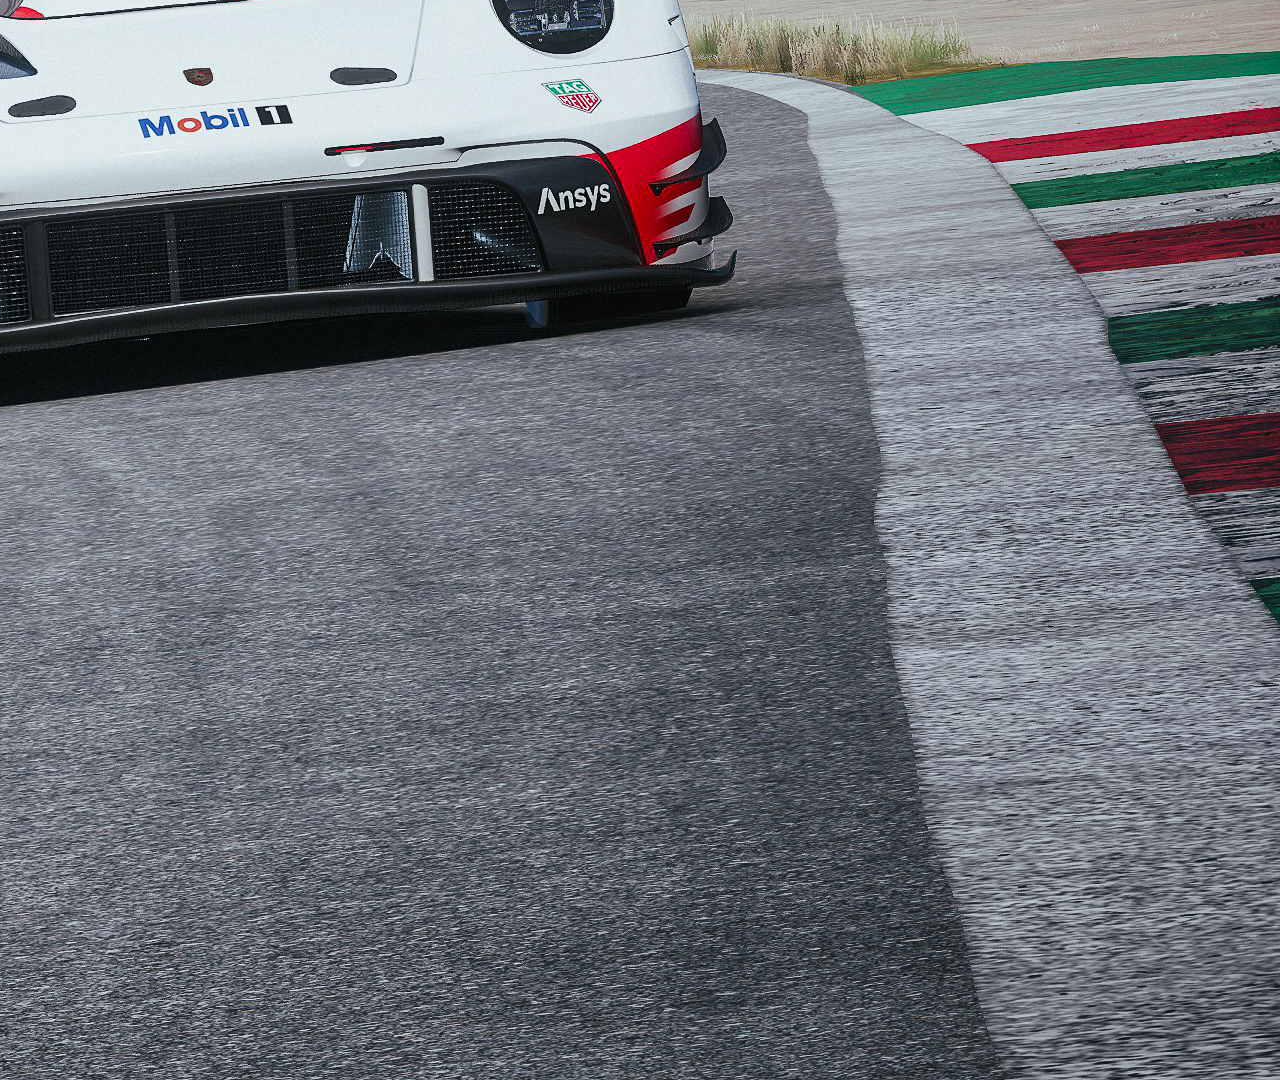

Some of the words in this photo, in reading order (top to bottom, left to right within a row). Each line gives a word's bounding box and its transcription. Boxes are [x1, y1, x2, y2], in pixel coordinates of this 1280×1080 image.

[549, 80, 590, 95] TAG
[559, 92, 599, 111] HEUER
[138, 108, 250, 138] Mobil
[263, 105, 284, 125] 1
[537, 183, 611, 215] Ansys
